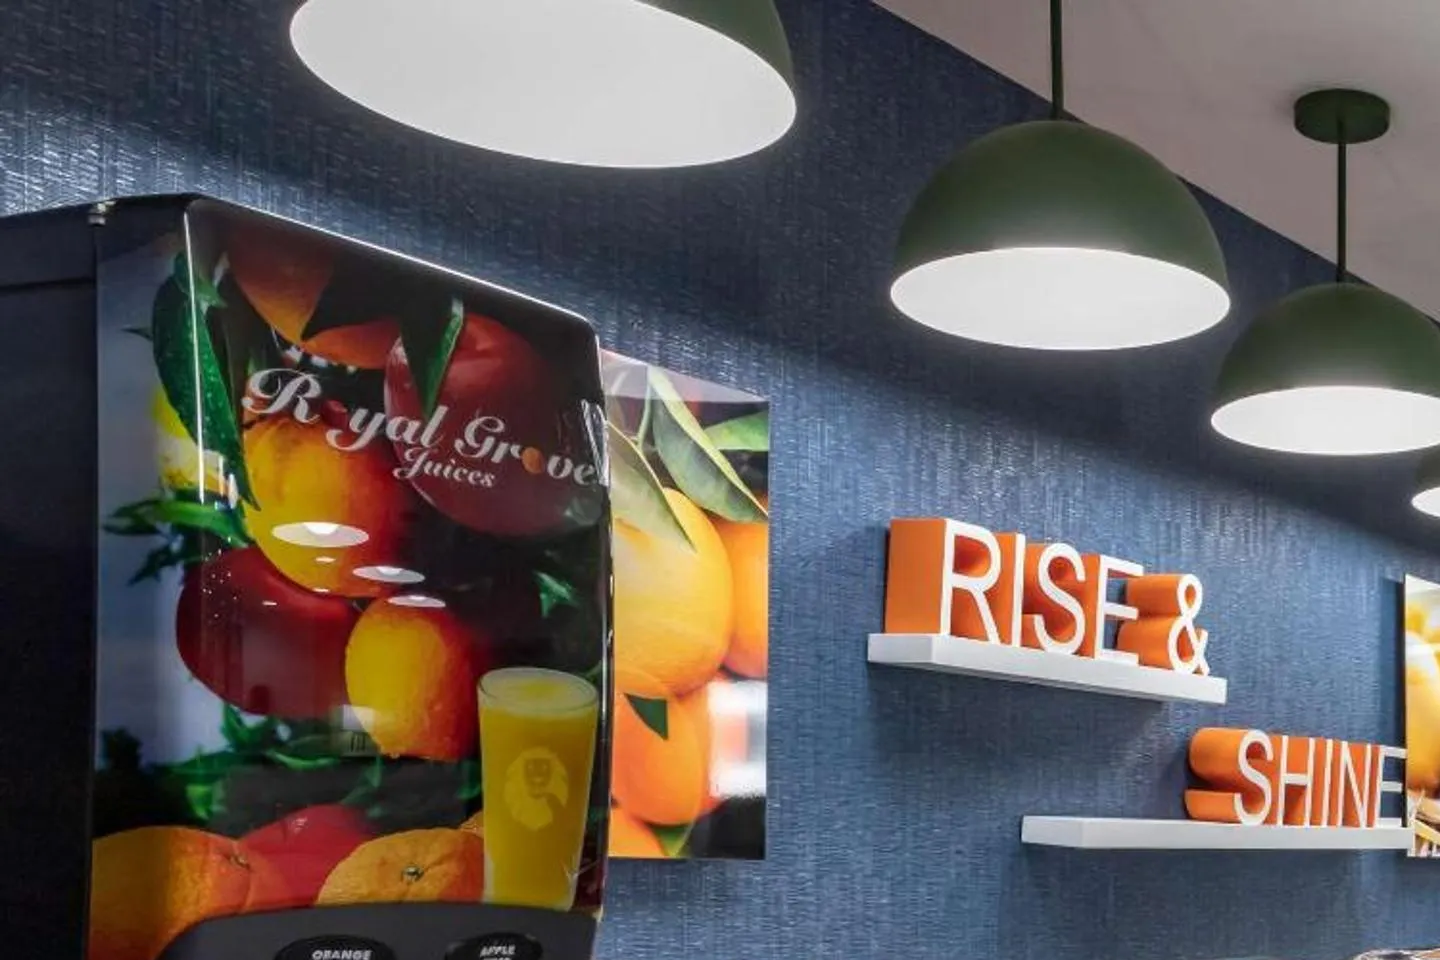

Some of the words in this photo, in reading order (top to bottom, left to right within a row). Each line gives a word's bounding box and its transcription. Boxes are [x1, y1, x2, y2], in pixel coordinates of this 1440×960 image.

[392, 446, 495, 488] Juices
[939, 517, 1145, 665] RISE
[1166, 573, 1210, 677] &
[1233, 728, 1408, 828] SHINE
[479, 945, 516, 957] APPLE
